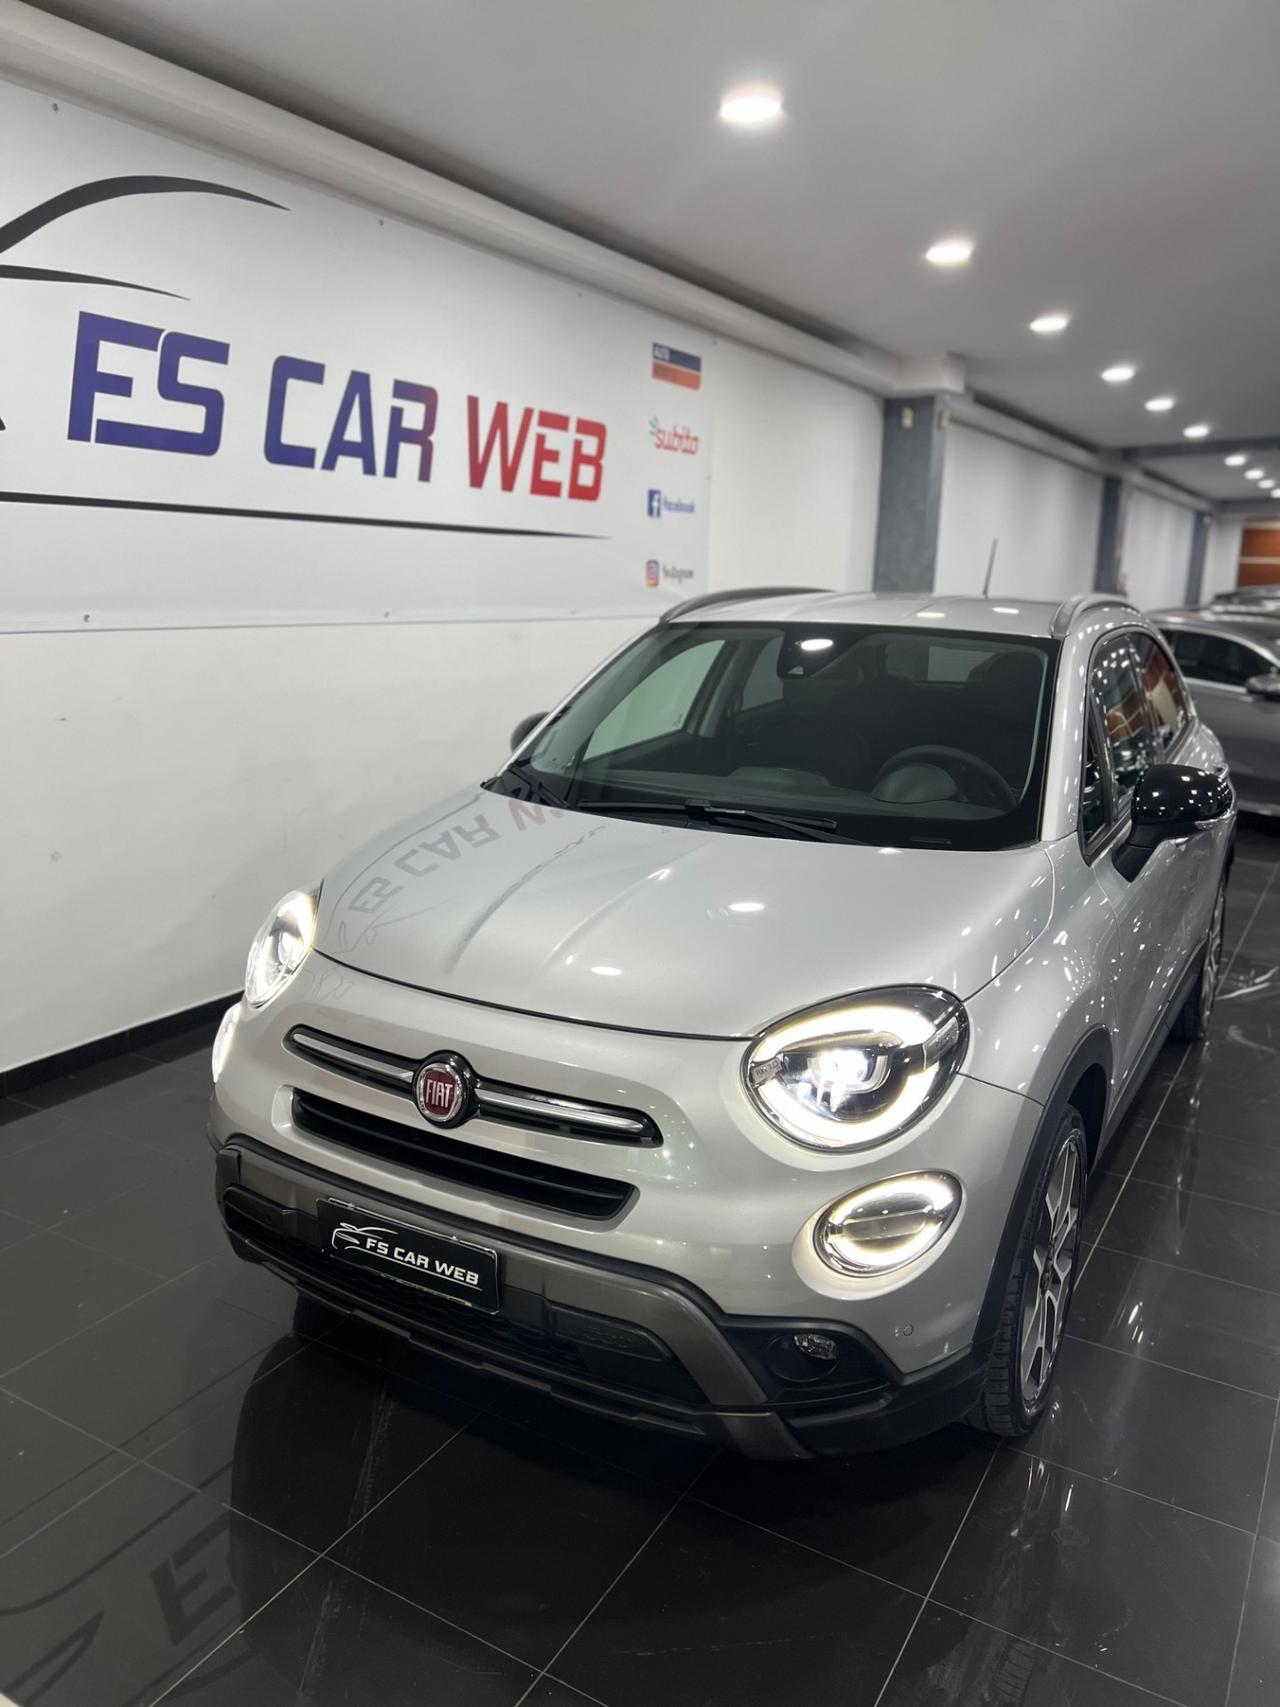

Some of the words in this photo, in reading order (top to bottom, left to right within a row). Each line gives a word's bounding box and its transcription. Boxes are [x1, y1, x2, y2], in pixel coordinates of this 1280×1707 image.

[264, 355, 439, 483] CAR
[466, 395, 608, 502] WEB
[654, 425, 699, 455] subito
[425, 1078, 453, 1108] FIAT
[365, 1237, 389, 1255] FS
[393, 1247, 430, 1269] CAR
[434, 1260, 479, 1286] WEB
